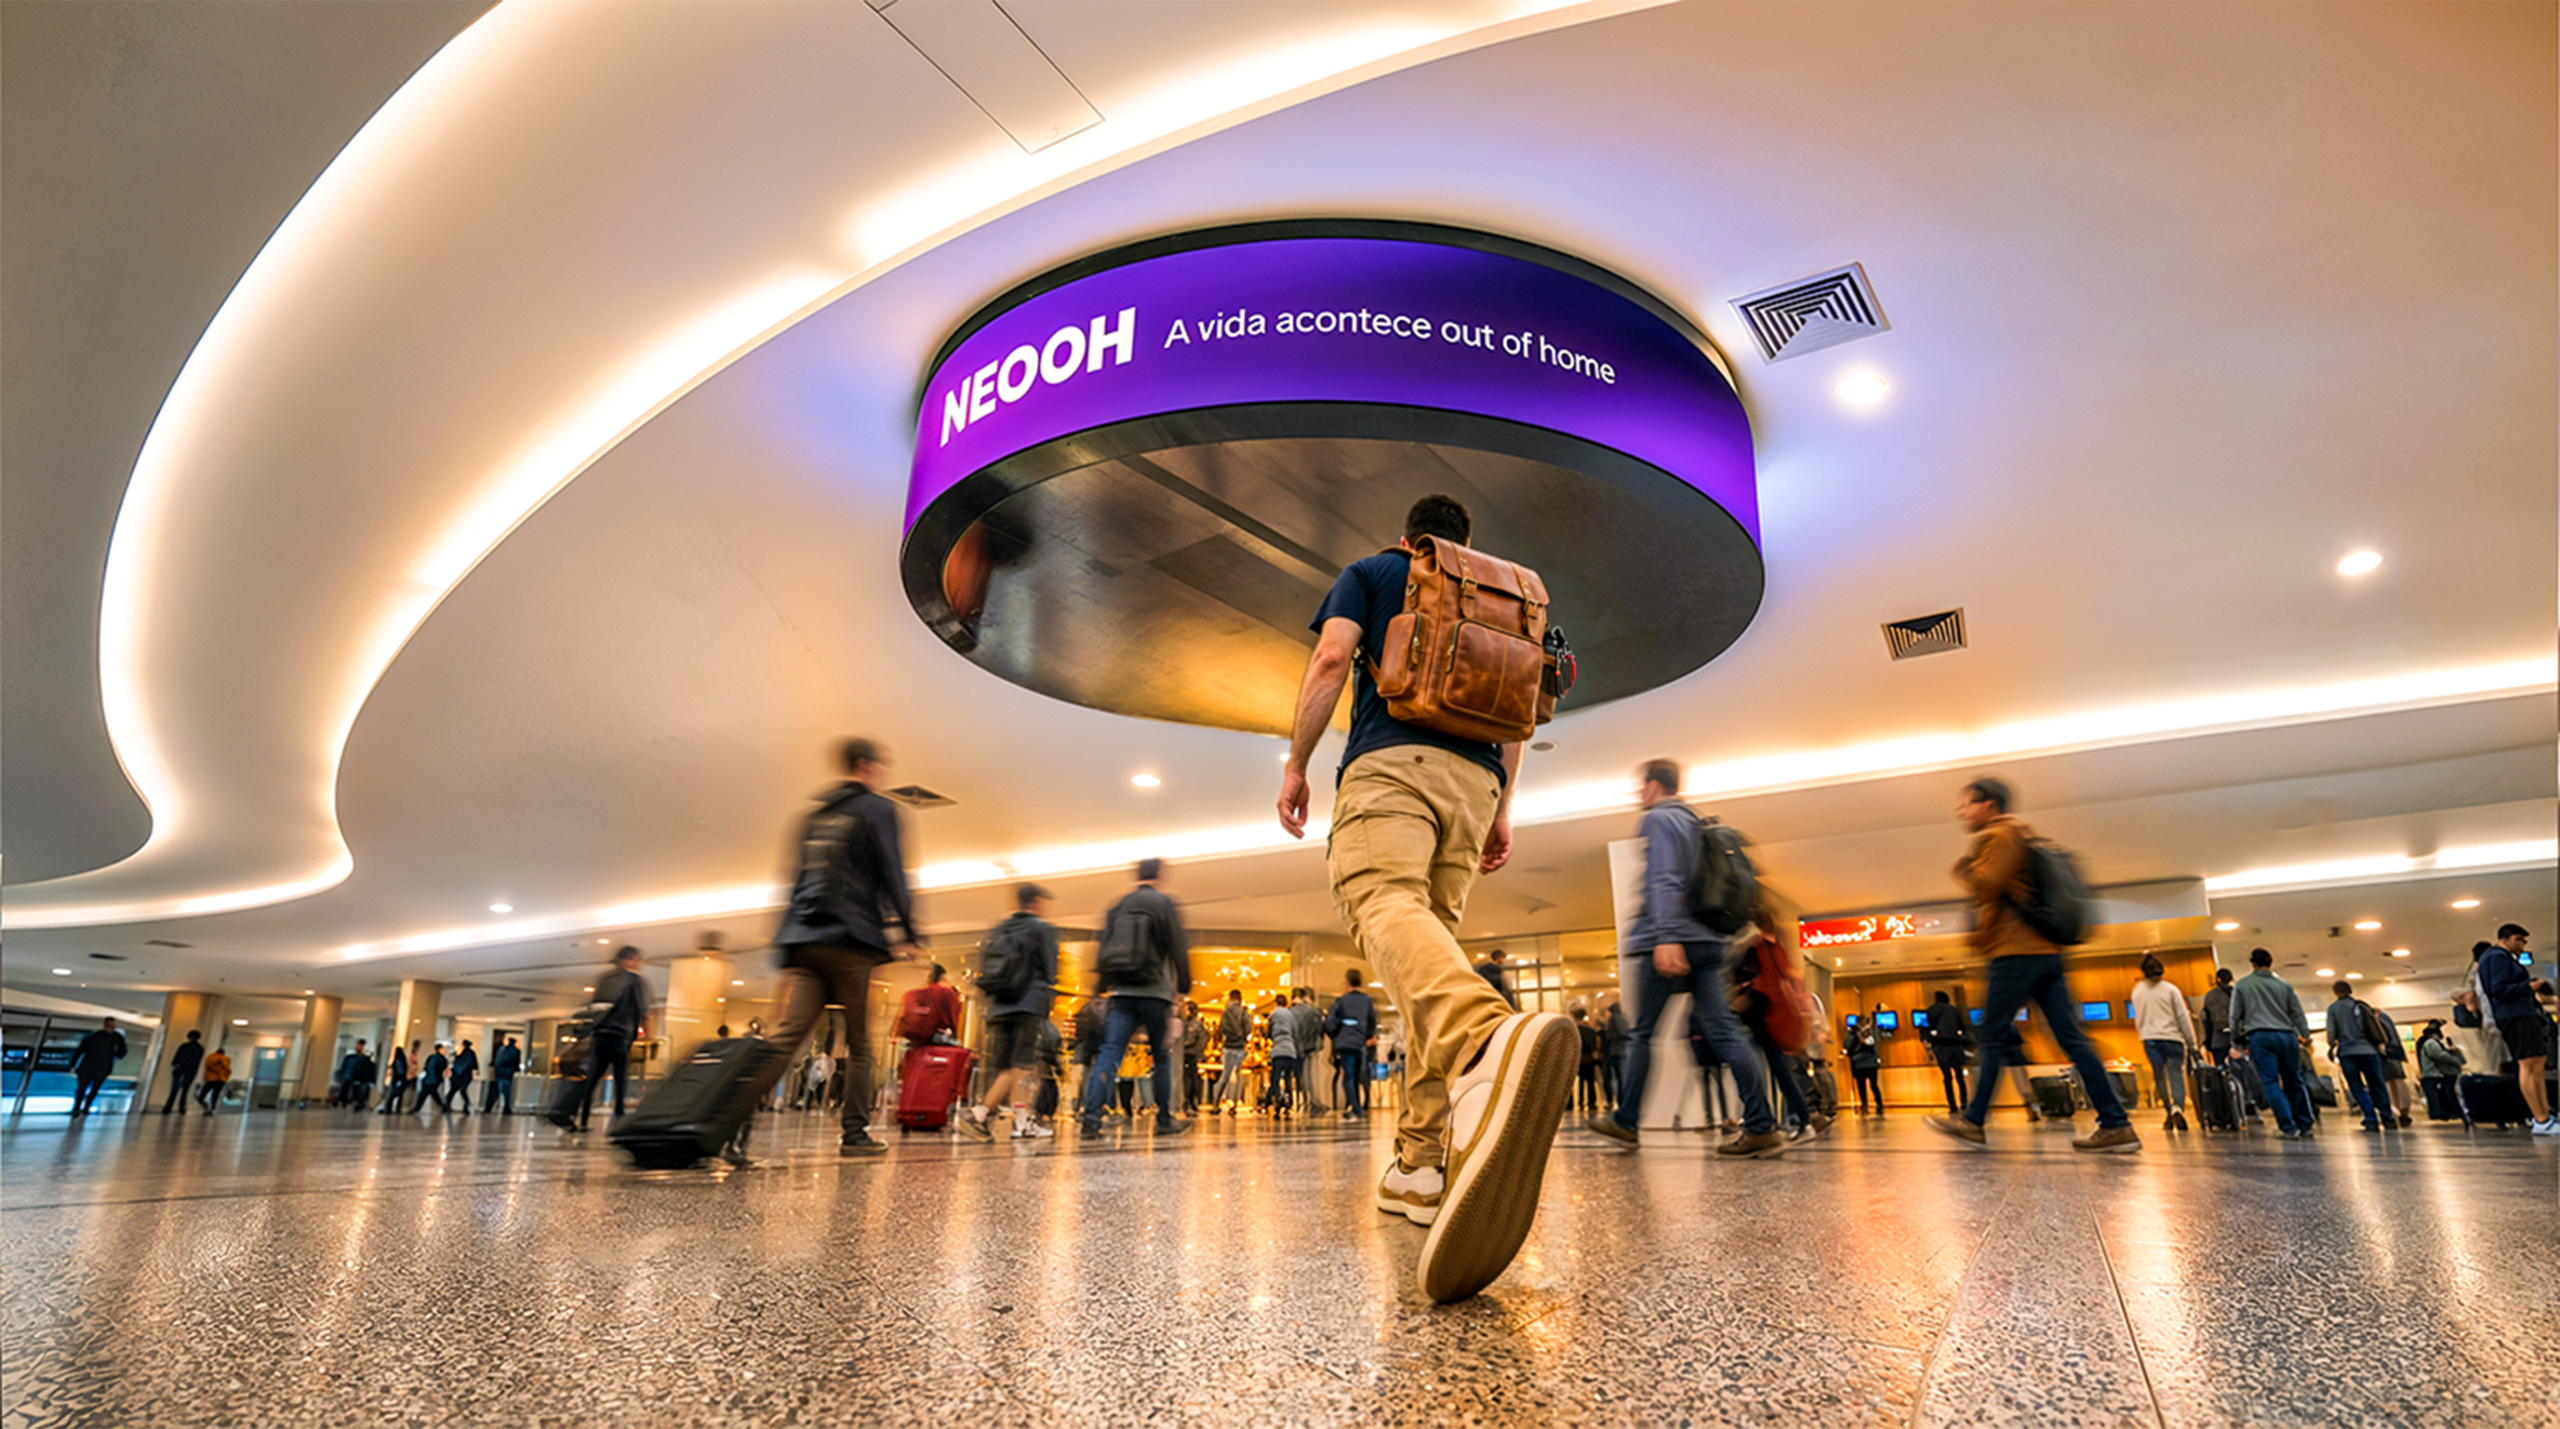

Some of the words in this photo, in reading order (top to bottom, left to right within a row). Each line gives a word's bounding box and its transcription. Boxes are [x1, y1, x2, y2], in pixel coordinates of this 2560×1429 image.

[939, 306, 1136, 448] NEOOH
[1164, 318, 1191, 349] A
[1197, 308, 1266, 341] vida
[1275, 311, 1432, 339] acontece
[1441, 321, 1495, 351] out
[1502, 331, 1533, 358] of
[1539, 335, 1617, 385] home
